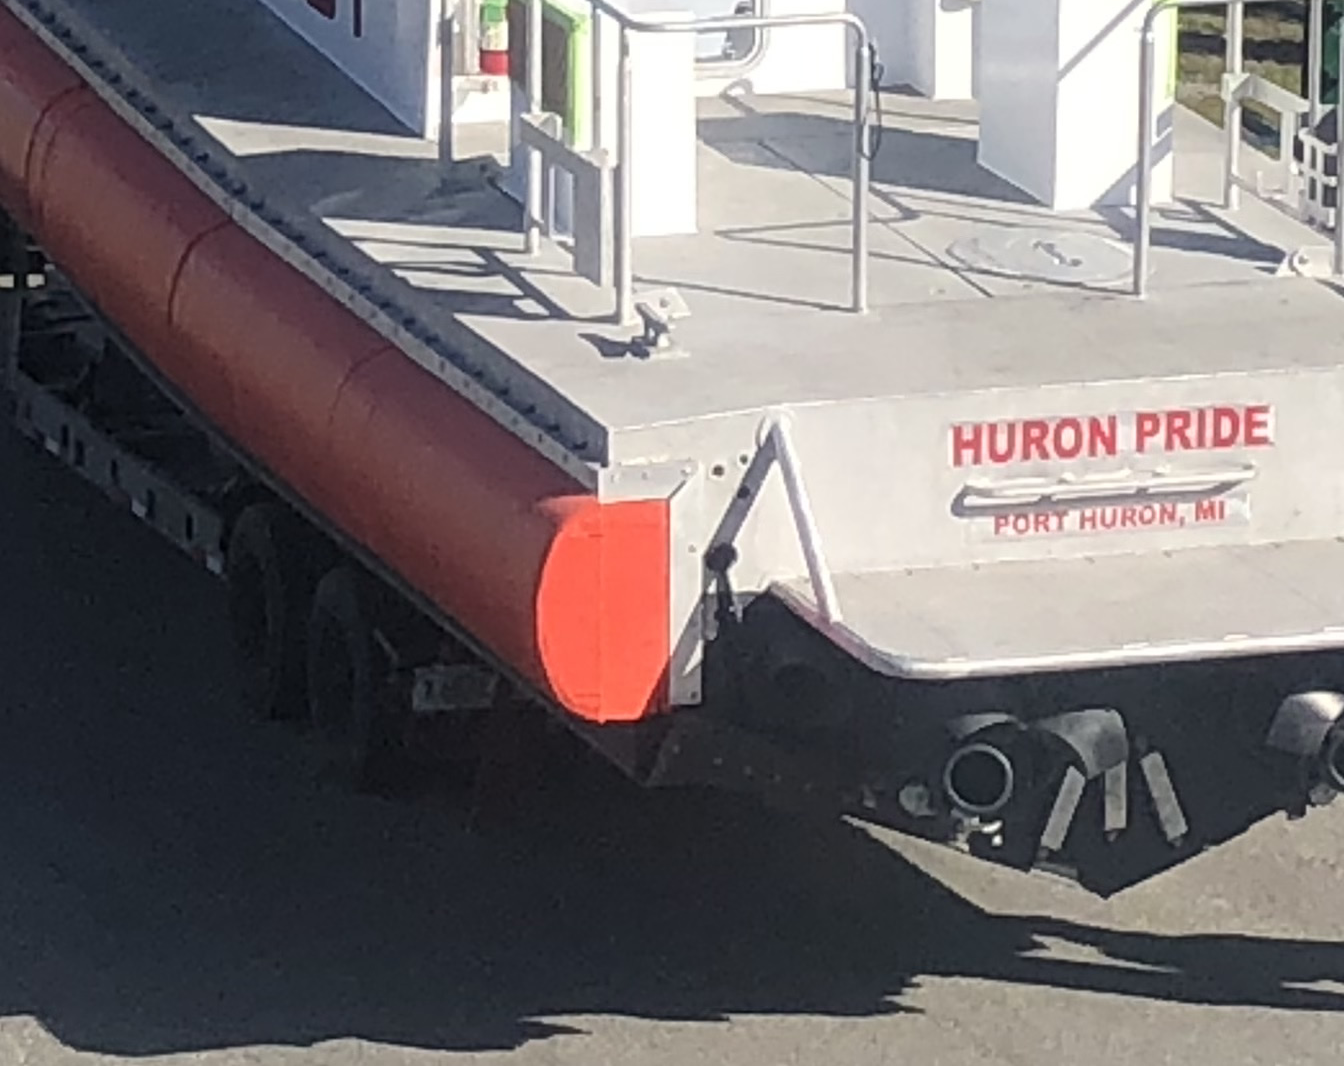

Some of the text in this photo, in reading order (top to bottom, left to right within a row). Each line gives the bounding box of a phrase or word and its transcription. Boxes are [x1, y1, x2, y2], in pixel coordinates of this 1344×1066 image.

[953, 406, 1273, 467] HURON PRIDE
[994, 500, 1226, 535] PORT HURON, MI
